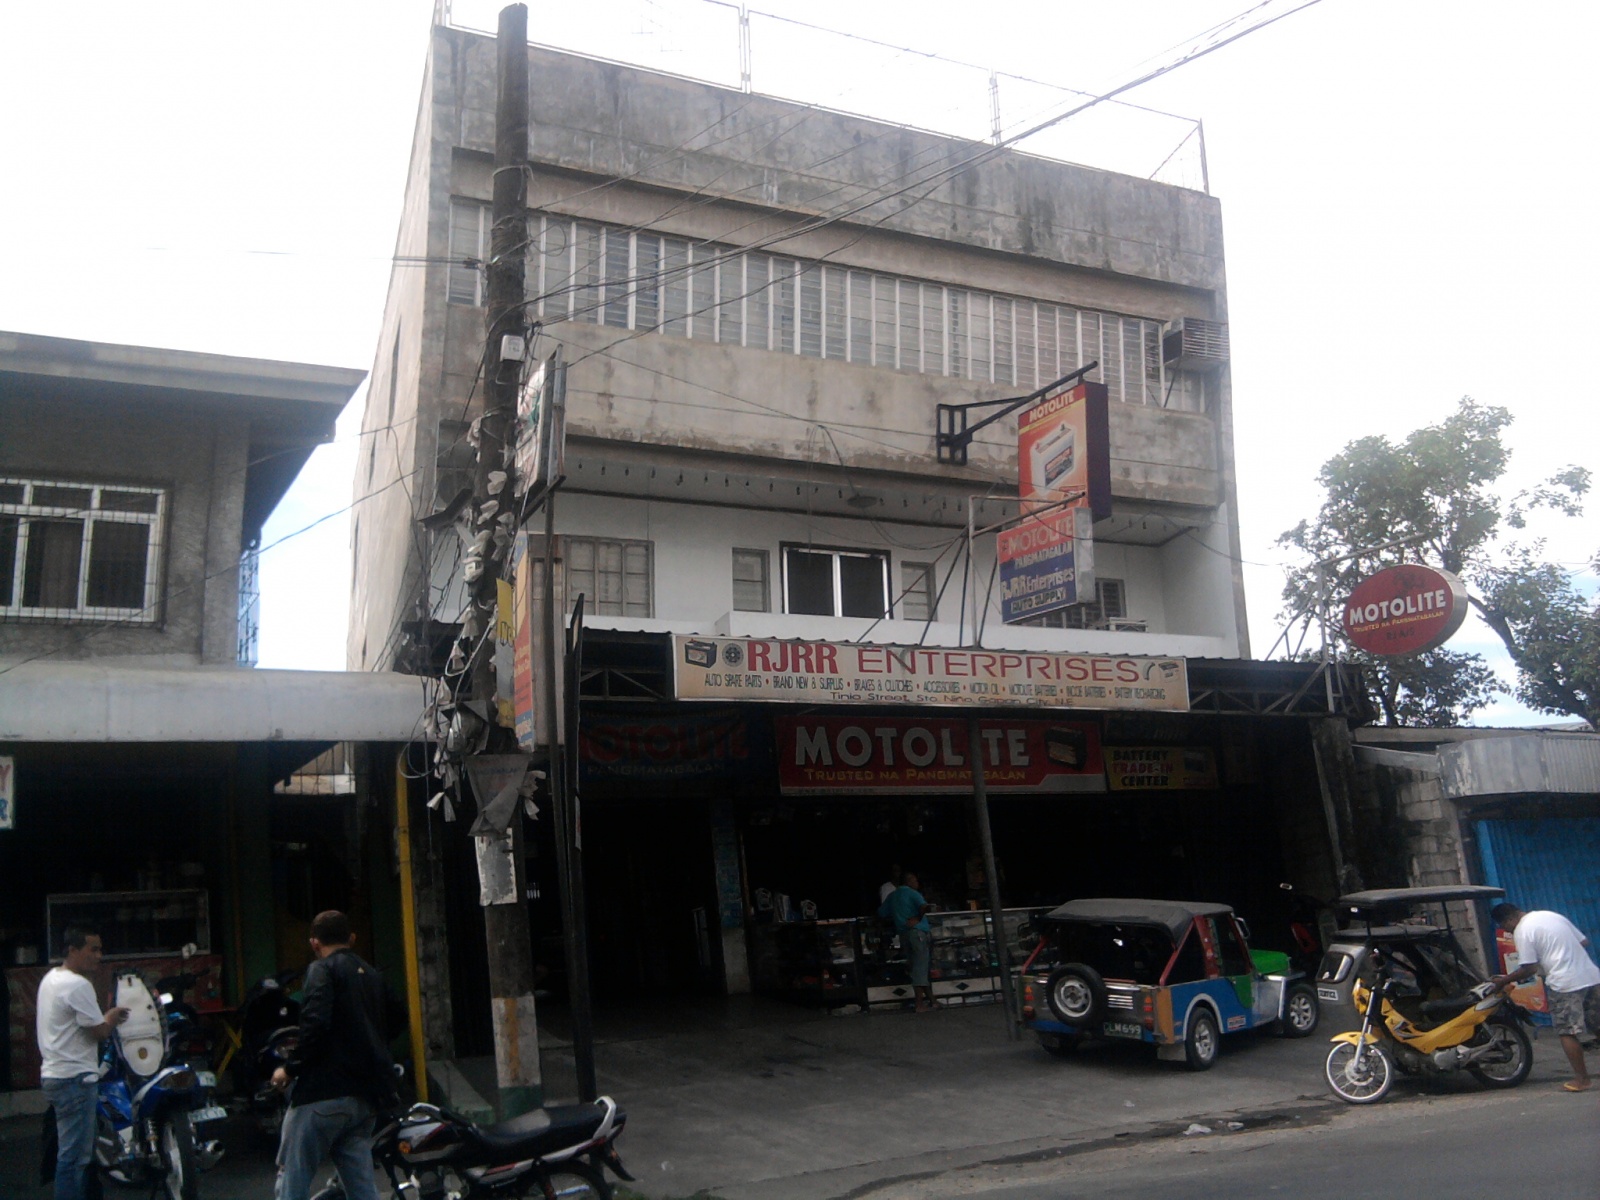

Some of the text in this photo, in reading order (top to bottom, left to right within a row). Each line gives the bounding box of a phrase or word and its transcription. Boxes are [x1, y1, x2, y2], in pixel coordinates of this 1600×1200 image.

[1029, 390, 1075, 422] MOTOLITE
[1008, 515, 1073, 555] MOTOLITE
[1034, 587, 1066, 606] SUPPLY
[1349, 589, 1447, 626] MOTOLITE
[747, 640, 1140, 683] RJRR ENTERPRISES
[704, 673, 722, 687] AUTO
[724, 674, 742, 687] SPARE
[745, 674, 762, 688] PARTS
[773, 675, 793, 689] BRAND
[796, 676, 809, 689] NEW
[854, 678, 876, 692] BRAKES
[830, 692, 861, 700] Tinio
[795, 726, 1031, 767] MOTOLTE
[1113, 750, 1168, 760] BATTERY
[804, 768, 1026, 781] TRUSTED NA PANGMATGALAN
[1121, 775, 1169, 787] CENTER
